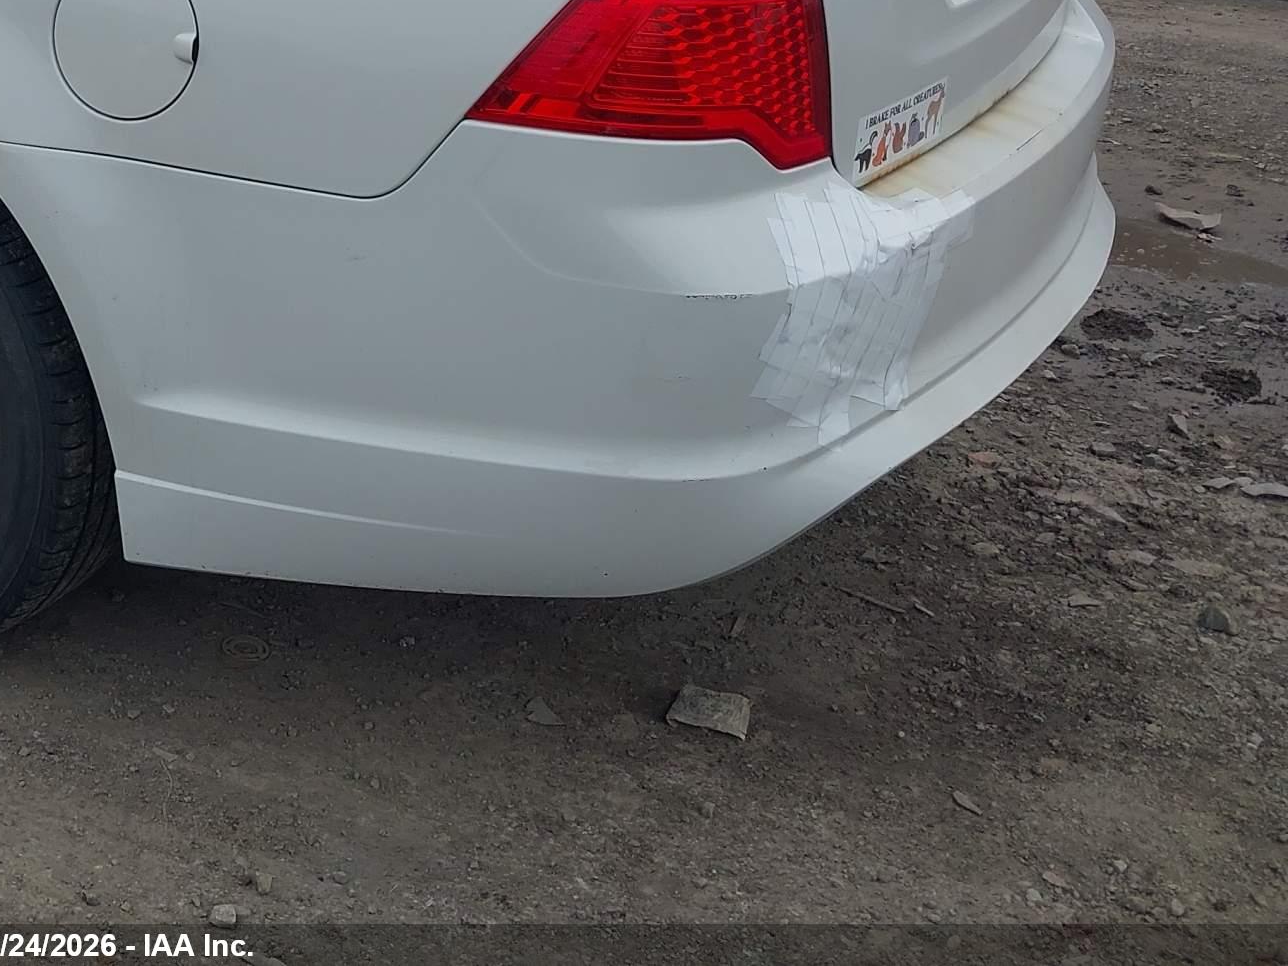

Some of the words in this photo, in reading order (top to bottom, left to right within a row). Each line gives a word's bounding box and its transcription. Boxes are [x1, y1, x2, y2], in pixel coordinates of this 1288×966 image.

[869, 110, 889, 128] BRAKE
[890, 105, 901, 116] FOR
[902, 98, 912, 112] ALL
